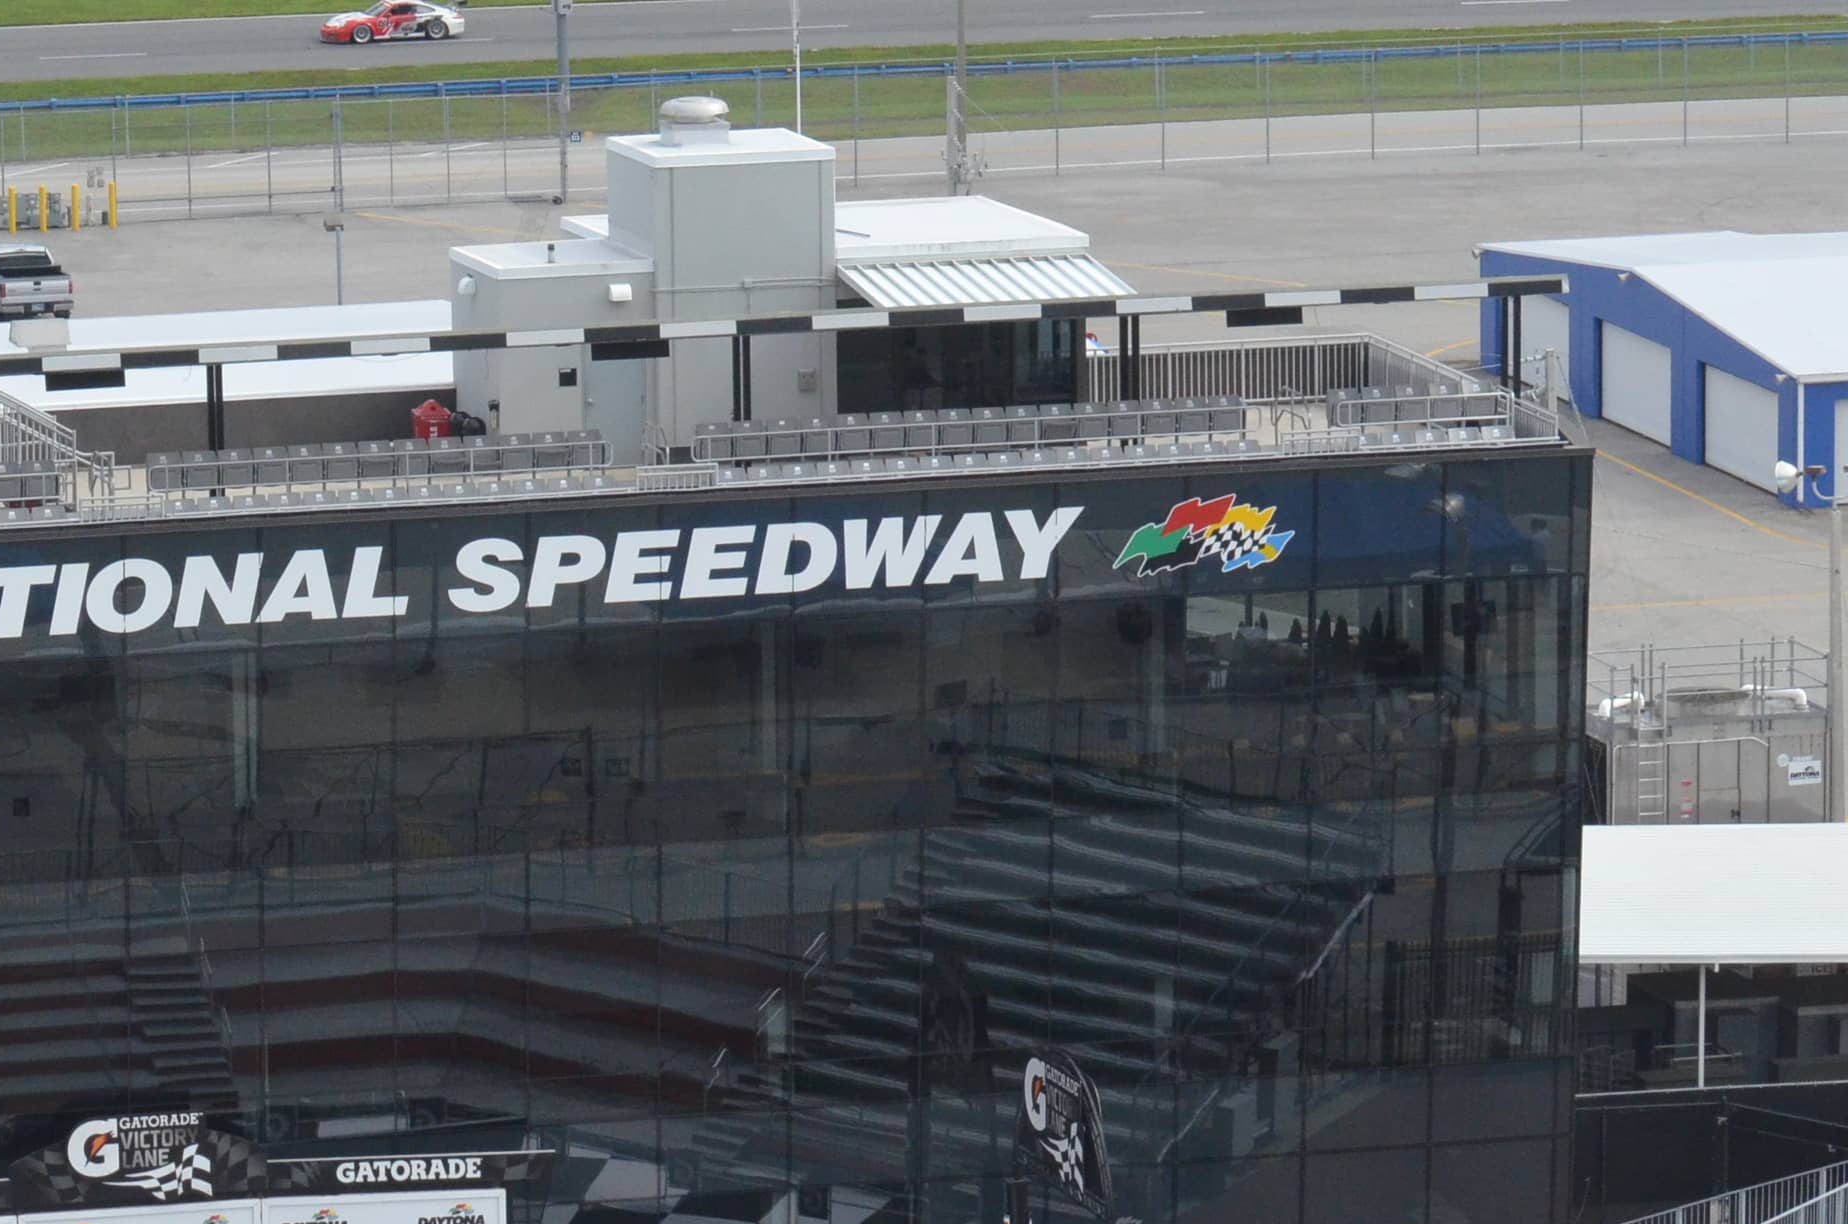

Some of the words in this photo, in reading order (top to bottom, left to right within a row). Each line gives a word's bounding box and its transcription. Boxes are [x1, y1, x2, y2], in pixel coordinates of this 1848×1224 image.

[447, 506, 1084, 613] SPEEDWAY
[1024, 1057, 1046, 1131] G
[119, 1112, 200, 1130] GATORADE
[67, 1118, 120, 1179] G
[120, 1127, 199, 1150] VICTORY
[122, 1149, 170, 1169] LANE
[336, 1157, 483, 1184] GATORADE
